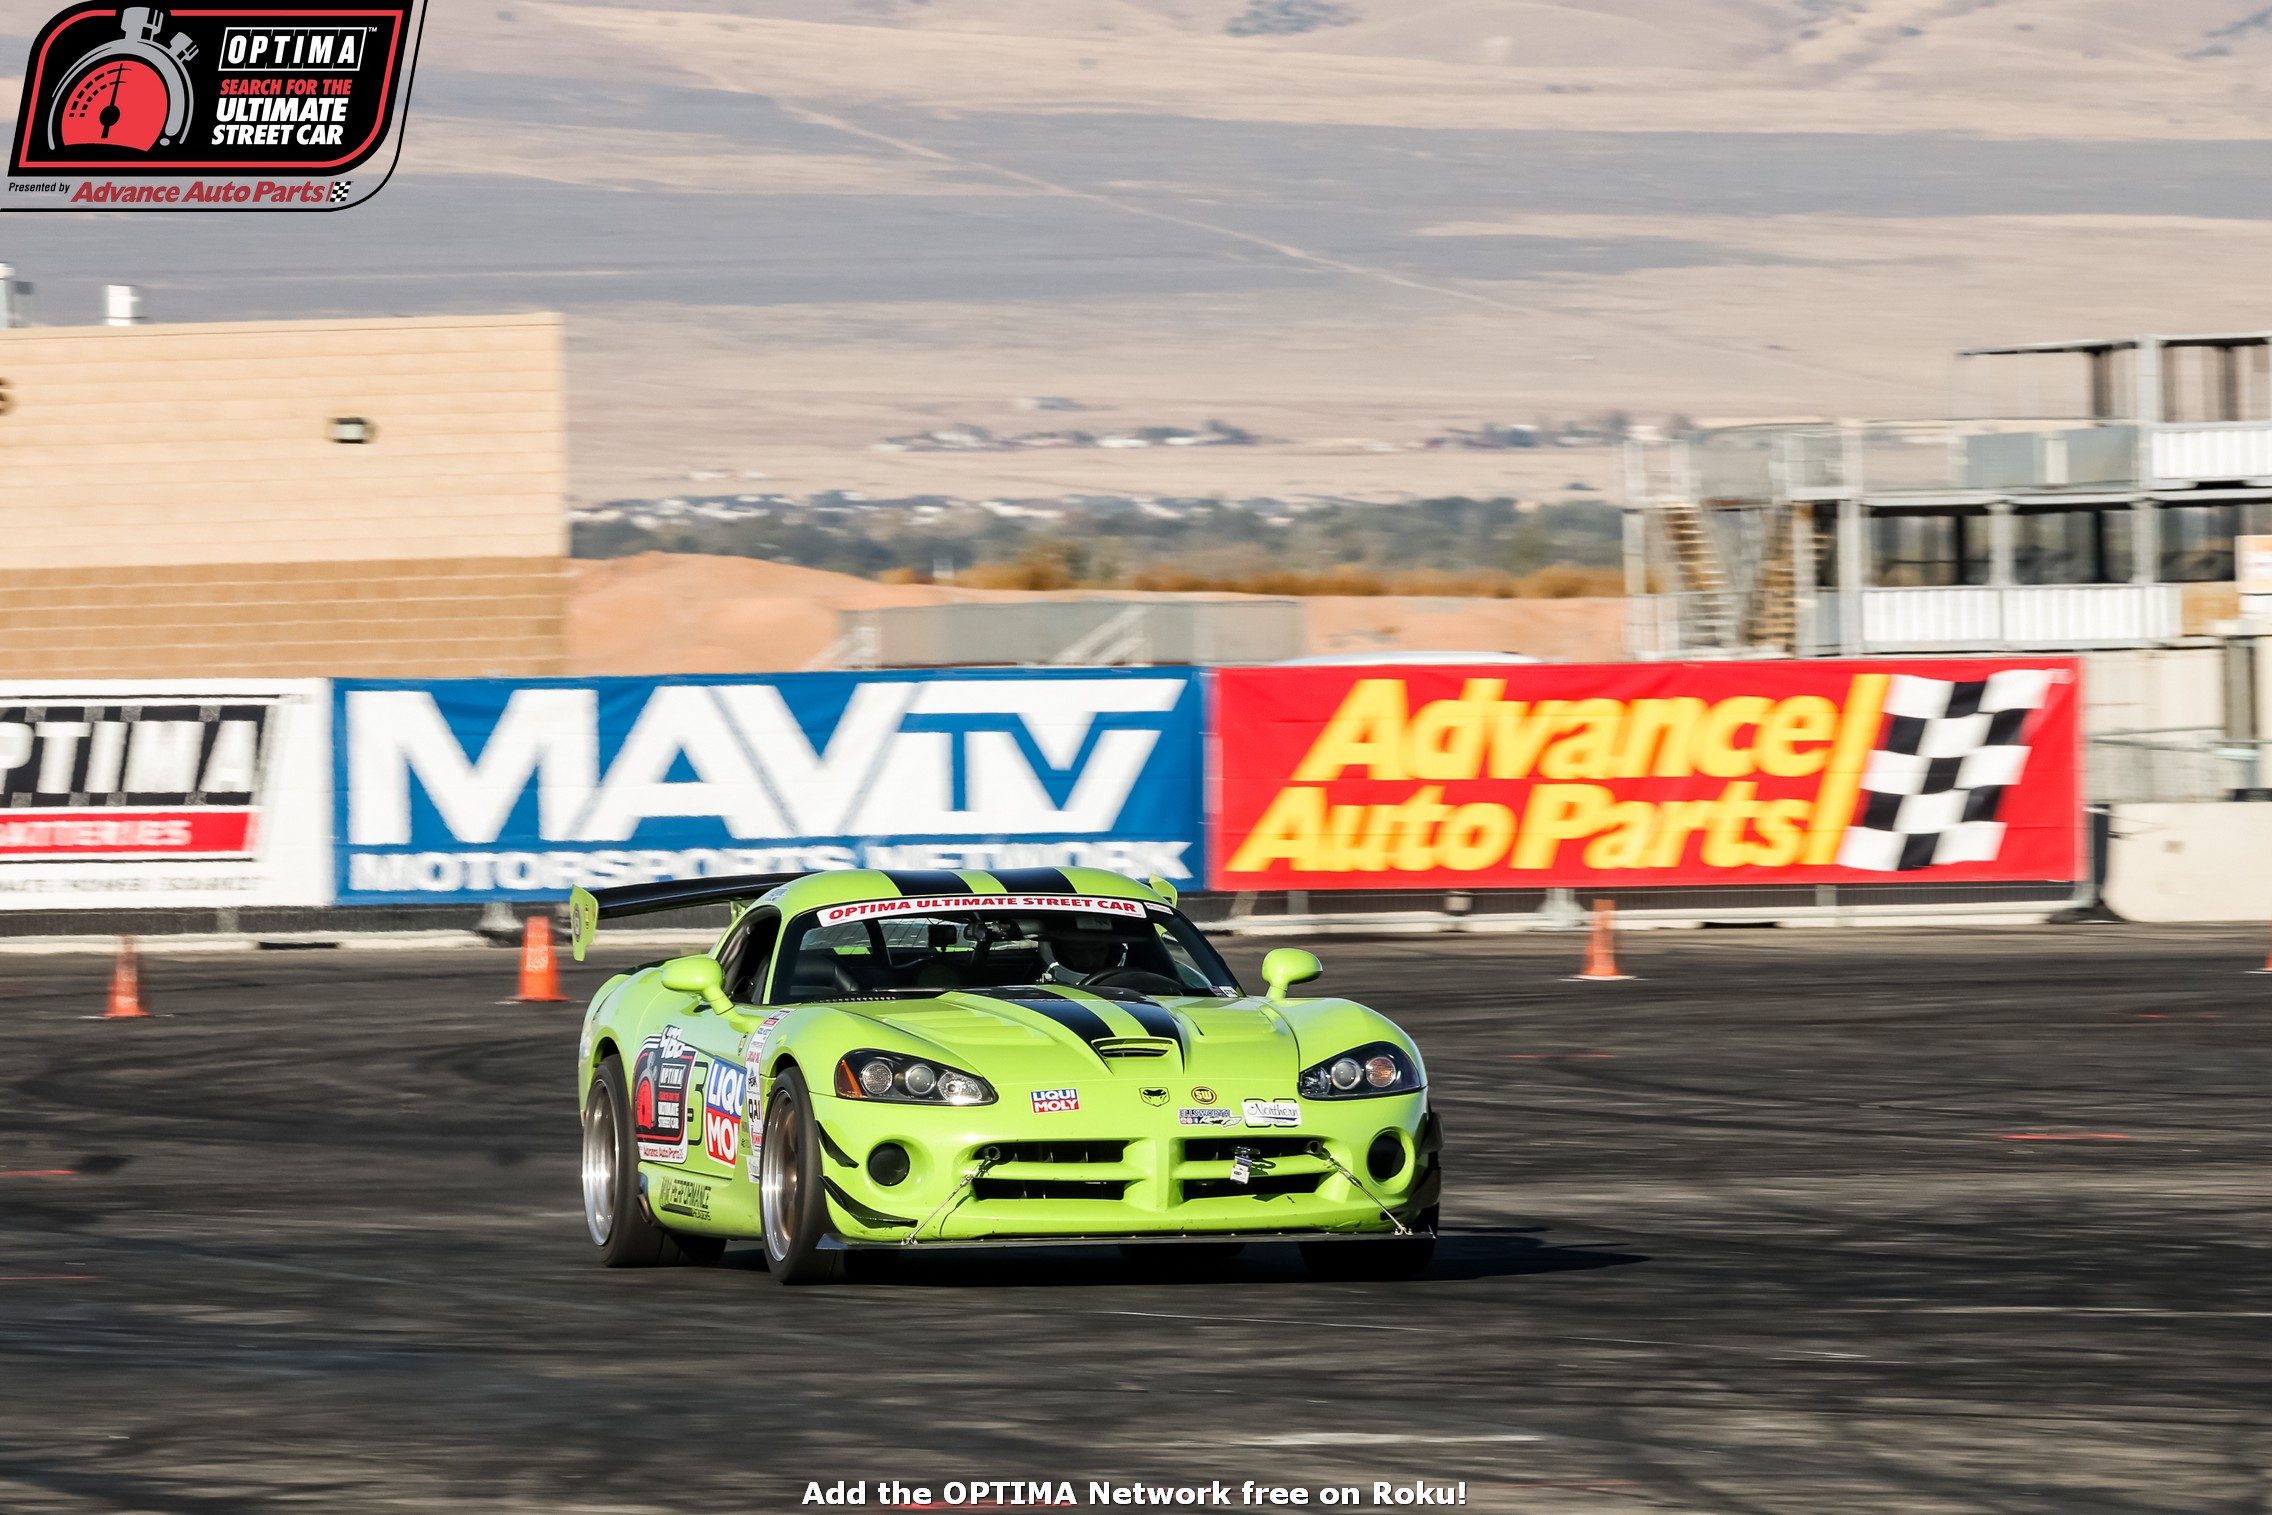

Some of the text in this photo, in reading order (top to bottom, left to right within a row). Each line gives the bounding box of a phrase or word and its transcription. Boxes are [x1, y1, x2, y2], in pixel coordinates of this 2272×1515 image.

[1291, 677, 1836, 781] Advance
[1225, 782, 1812, 872] Auto Parts
[347, 841, 1196, 891] MOTORSPORTS NETWORK
[829, 901, 911, 920] OPTIMA
[917, 898, 1018, 908] ULTIMATE
[1023, 897, 1093, 907] STREET
[1097, 900, 1136, 912] CAR
[1032, 1089, 1076, 1101] LIQUI
[1195, 1090, 1213, 1100] SW
[1034, 1100, 1078, 1112] MOLY
[1248, 1102, 1299, 1117] Northern
